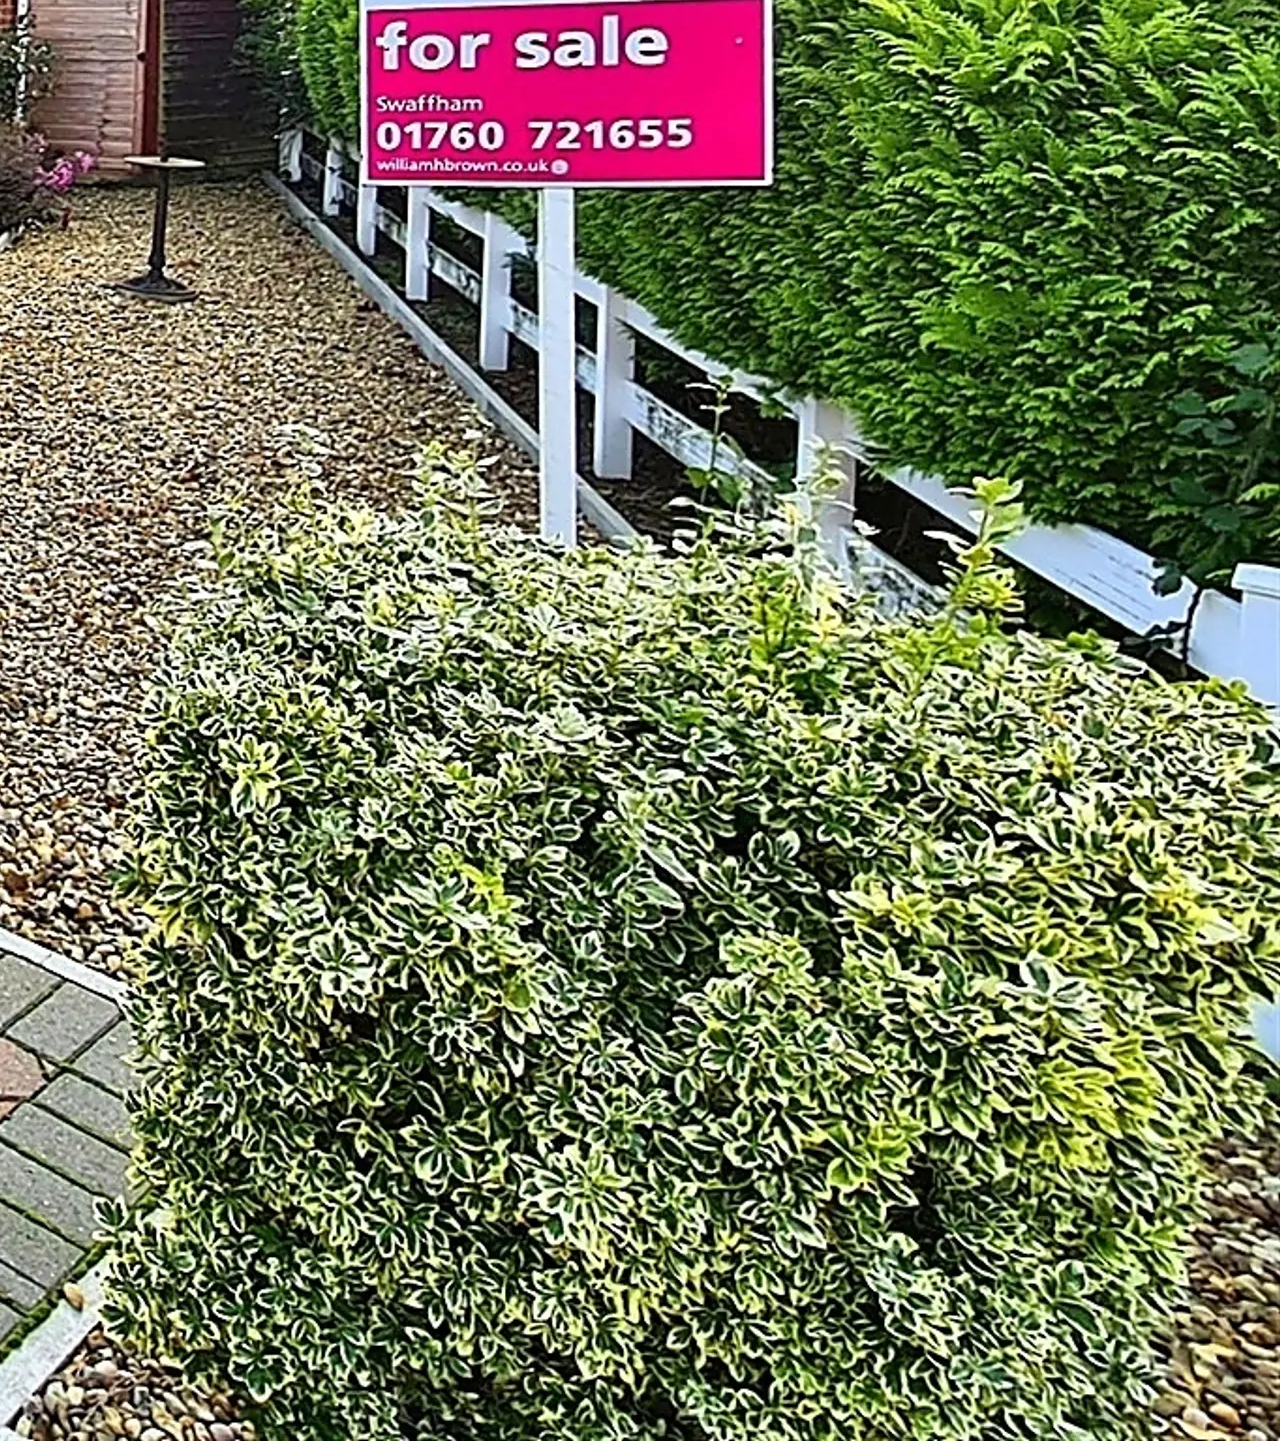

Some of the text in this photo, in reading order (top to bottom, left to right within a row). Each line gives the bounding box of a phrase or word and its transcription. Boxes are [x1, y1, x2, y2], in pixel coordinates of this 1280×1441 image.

[375, 14, 669, 70] for sale
[376, 94, 483, 112] Swaffham
[376, 118, 692, 150] 01760 721655
[376, 157, 549, 172] williamhbrown.co.uk
